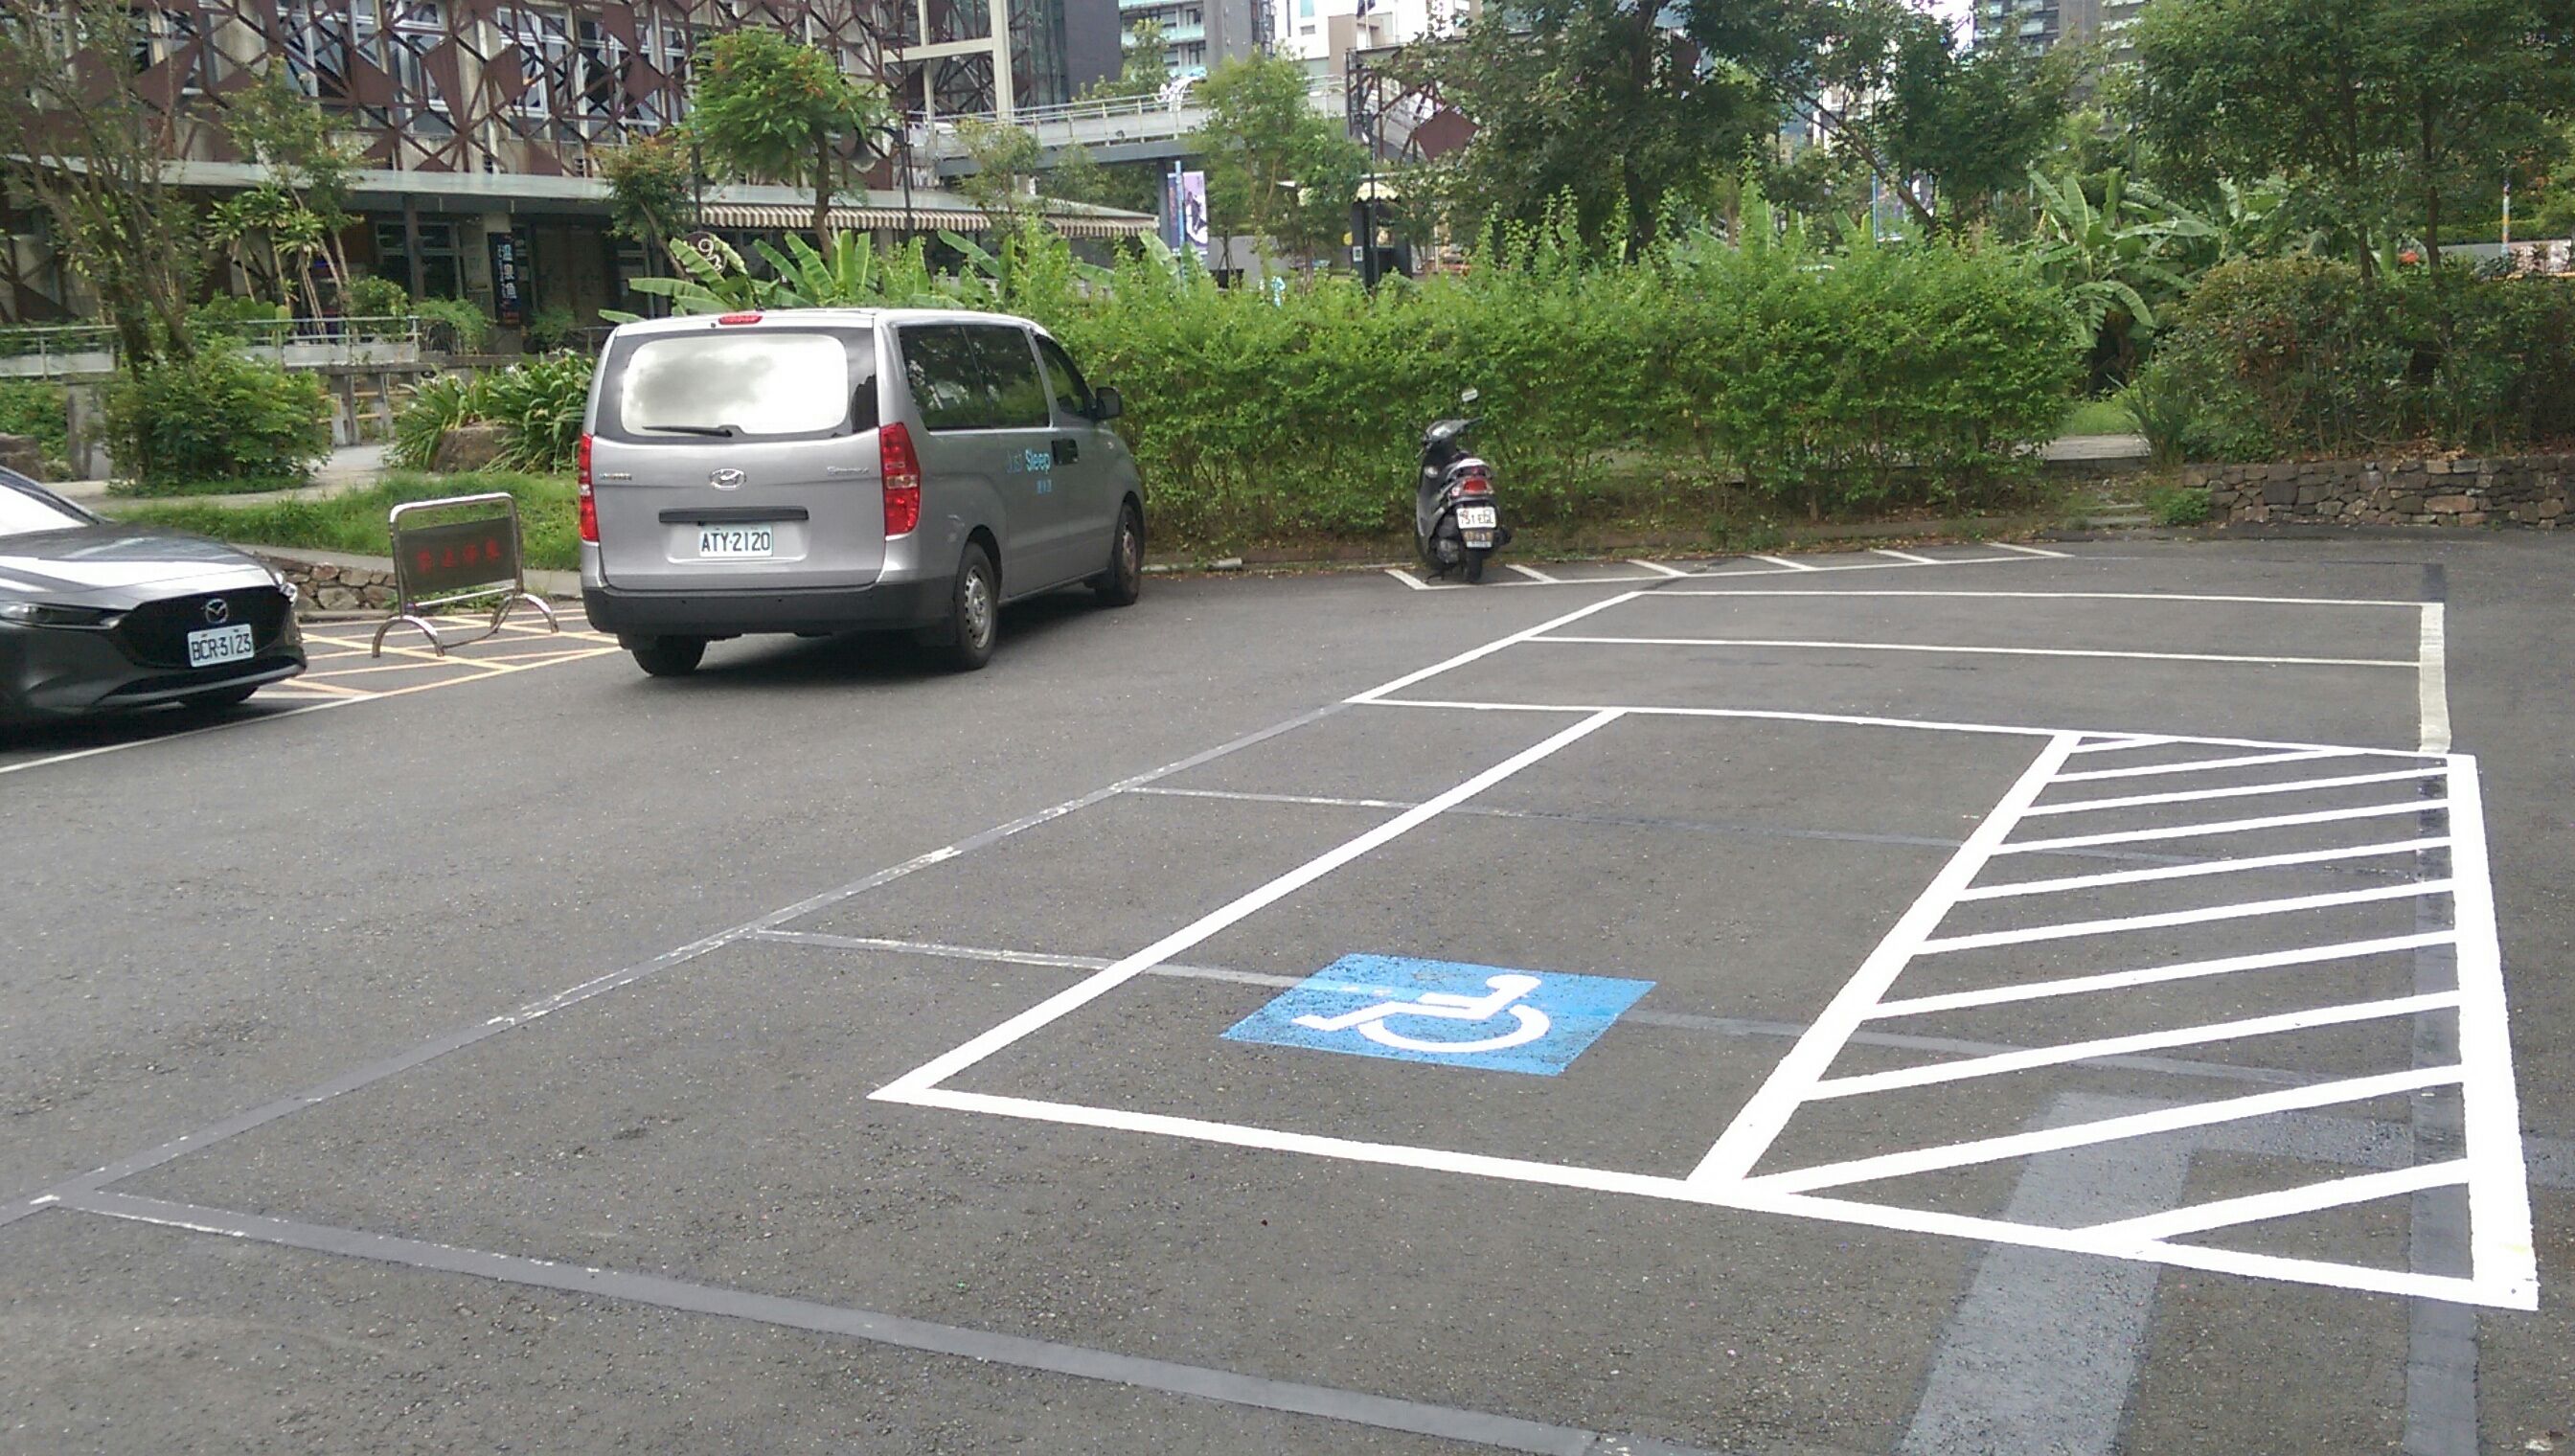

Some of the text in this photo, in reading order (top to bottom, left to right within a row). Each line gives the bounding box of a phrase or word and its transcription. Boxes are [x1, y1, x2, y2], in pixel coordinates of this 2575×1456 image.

[1025, 448, 1051, 475] Sleep
[701, 532, 770, 552] ATY-2120
[191, 633, 251, 661] BCR-3123
